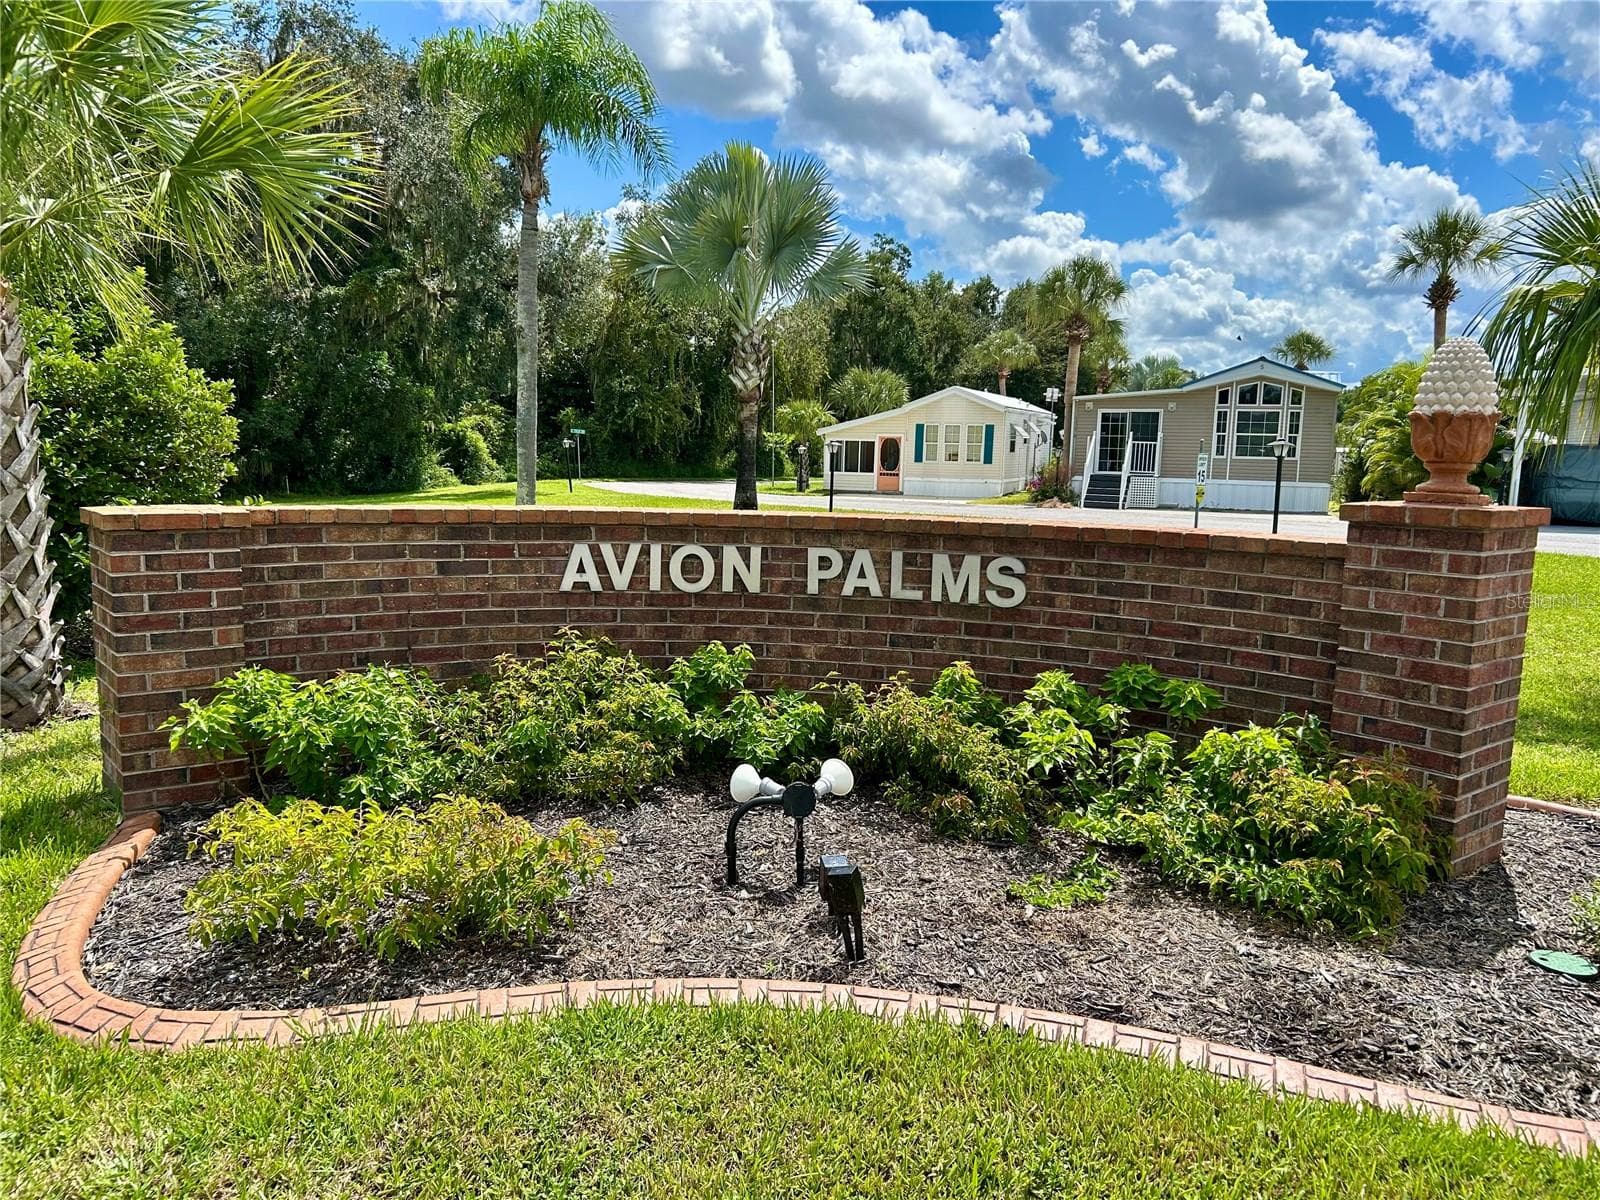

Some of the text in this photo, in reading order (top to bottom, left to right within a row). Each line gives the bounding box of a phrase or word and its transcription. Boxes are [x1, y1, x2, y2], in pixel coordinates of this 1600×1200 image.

[1198, 470, 1206, 483] 15
[559, 543, 1027, 608] AVION PALMS
